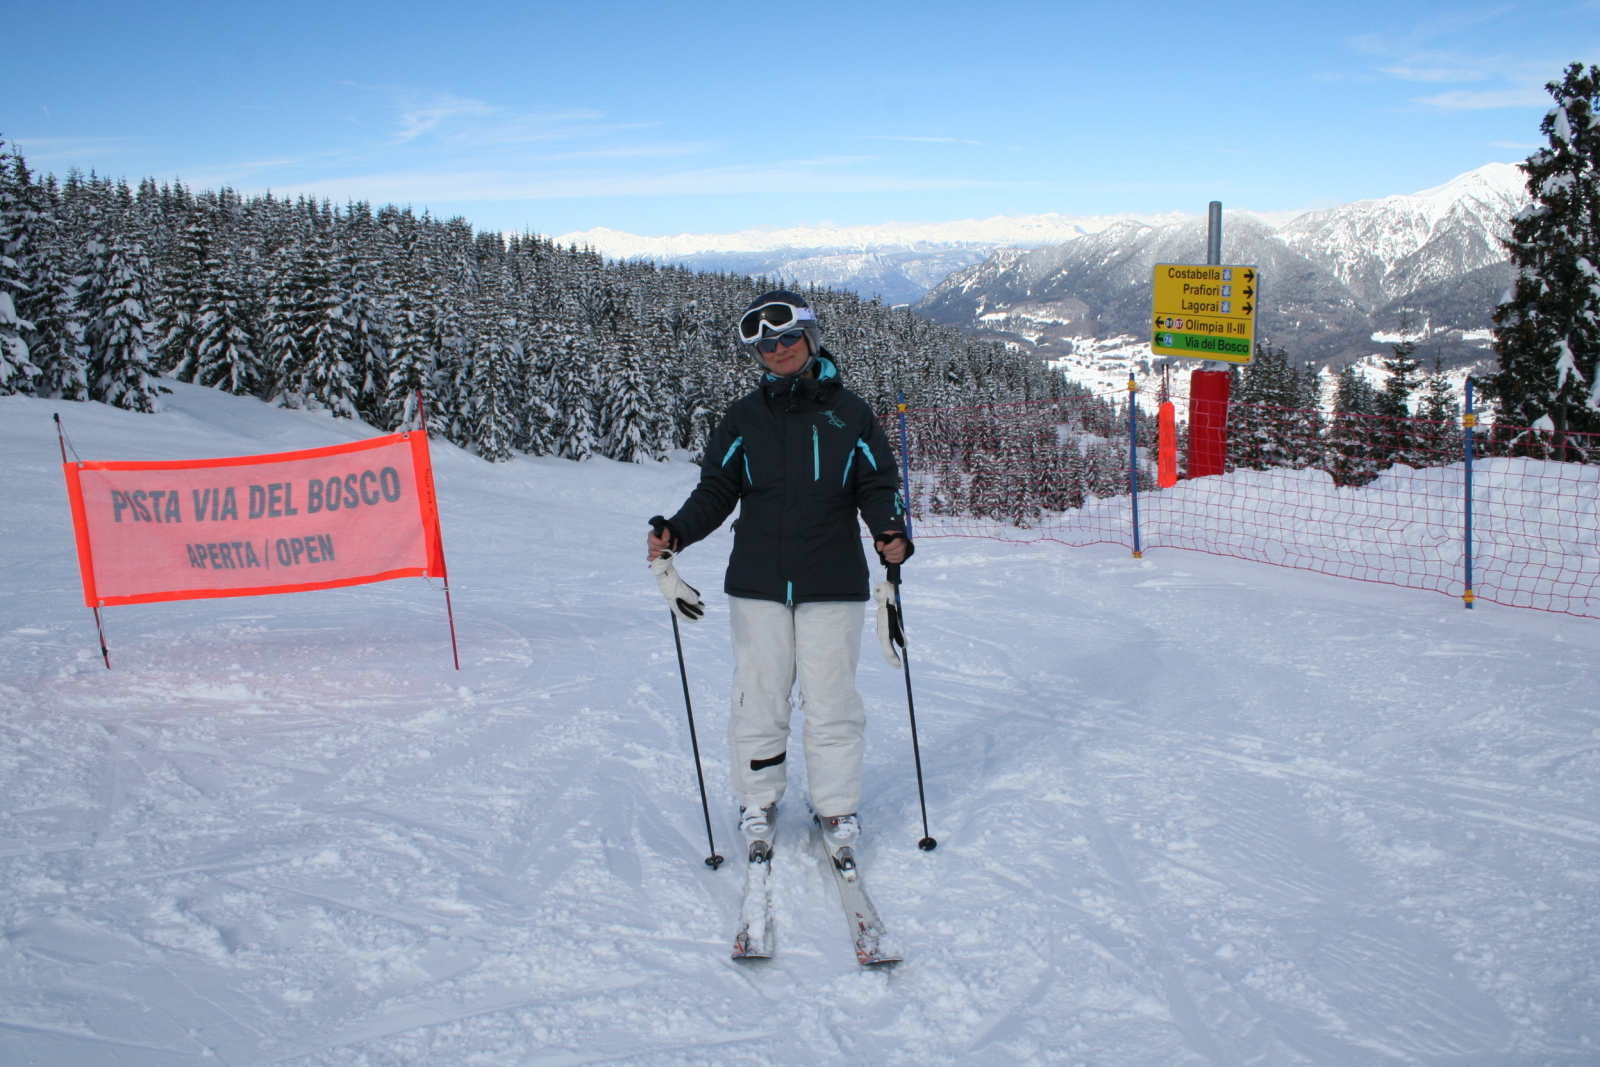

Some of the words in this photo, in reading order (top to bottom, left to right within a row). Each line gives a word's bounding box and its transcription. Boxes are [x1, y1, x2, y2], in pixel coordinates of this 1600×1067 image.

[1168, 267, 1220, 280] Costabella
[1183, 284, 1220, 296] Prafiori
[1181, 299, 1219, 313] Lagorai
[1165, 319, 1173, 327] 81
[1175, 320, 1183, 328] 87
[1185, 319, 1224, 334] Olimpia
[1226, 323, 1245, 335] II-III
[1185, 336, 1199, 348] Via
[1201, 339, 1216, 350] del
[1218, 339, 1249, 353] Bosco
[113, 489, 182, 524] PISTA
[192, 486, 238, 522] VIA
[248, 482, 298, 520] DEL
[307, 466, 402, 514] BOSCO
[186, 540, 261, 570] APERTA
[277, 533, 336, 567] OPEN
